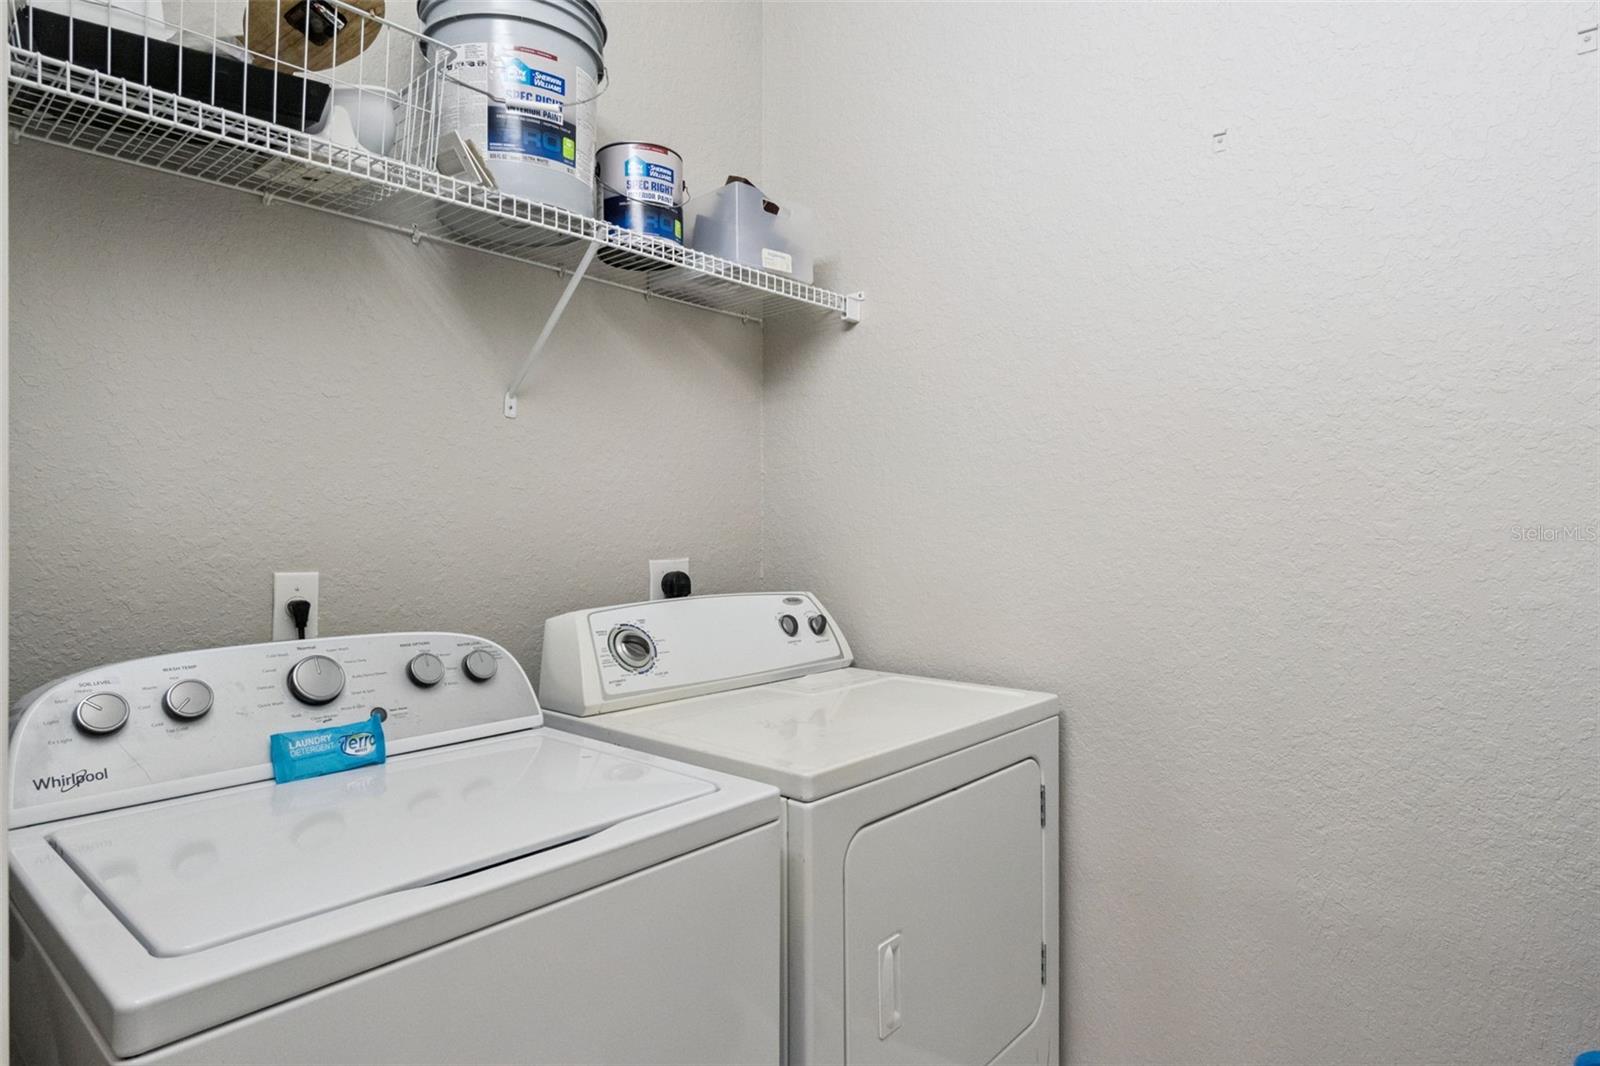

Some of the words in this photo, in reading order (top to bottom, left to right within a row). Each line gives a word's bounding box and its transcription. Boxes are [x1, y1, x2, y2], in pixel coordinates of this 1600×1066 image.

[533, 78, 562, 93] WILLIAMS
[534, 71, 562, 86] SHERWIN
[626, 179, 649, 191] SEC
[650, 181, 673, 196] RIGHT
[288, 733, 333, 749] LAUNDRY
[289, 742, 335, 758] DETERGENT
[32, 768, 108, 793] Whirlpool
